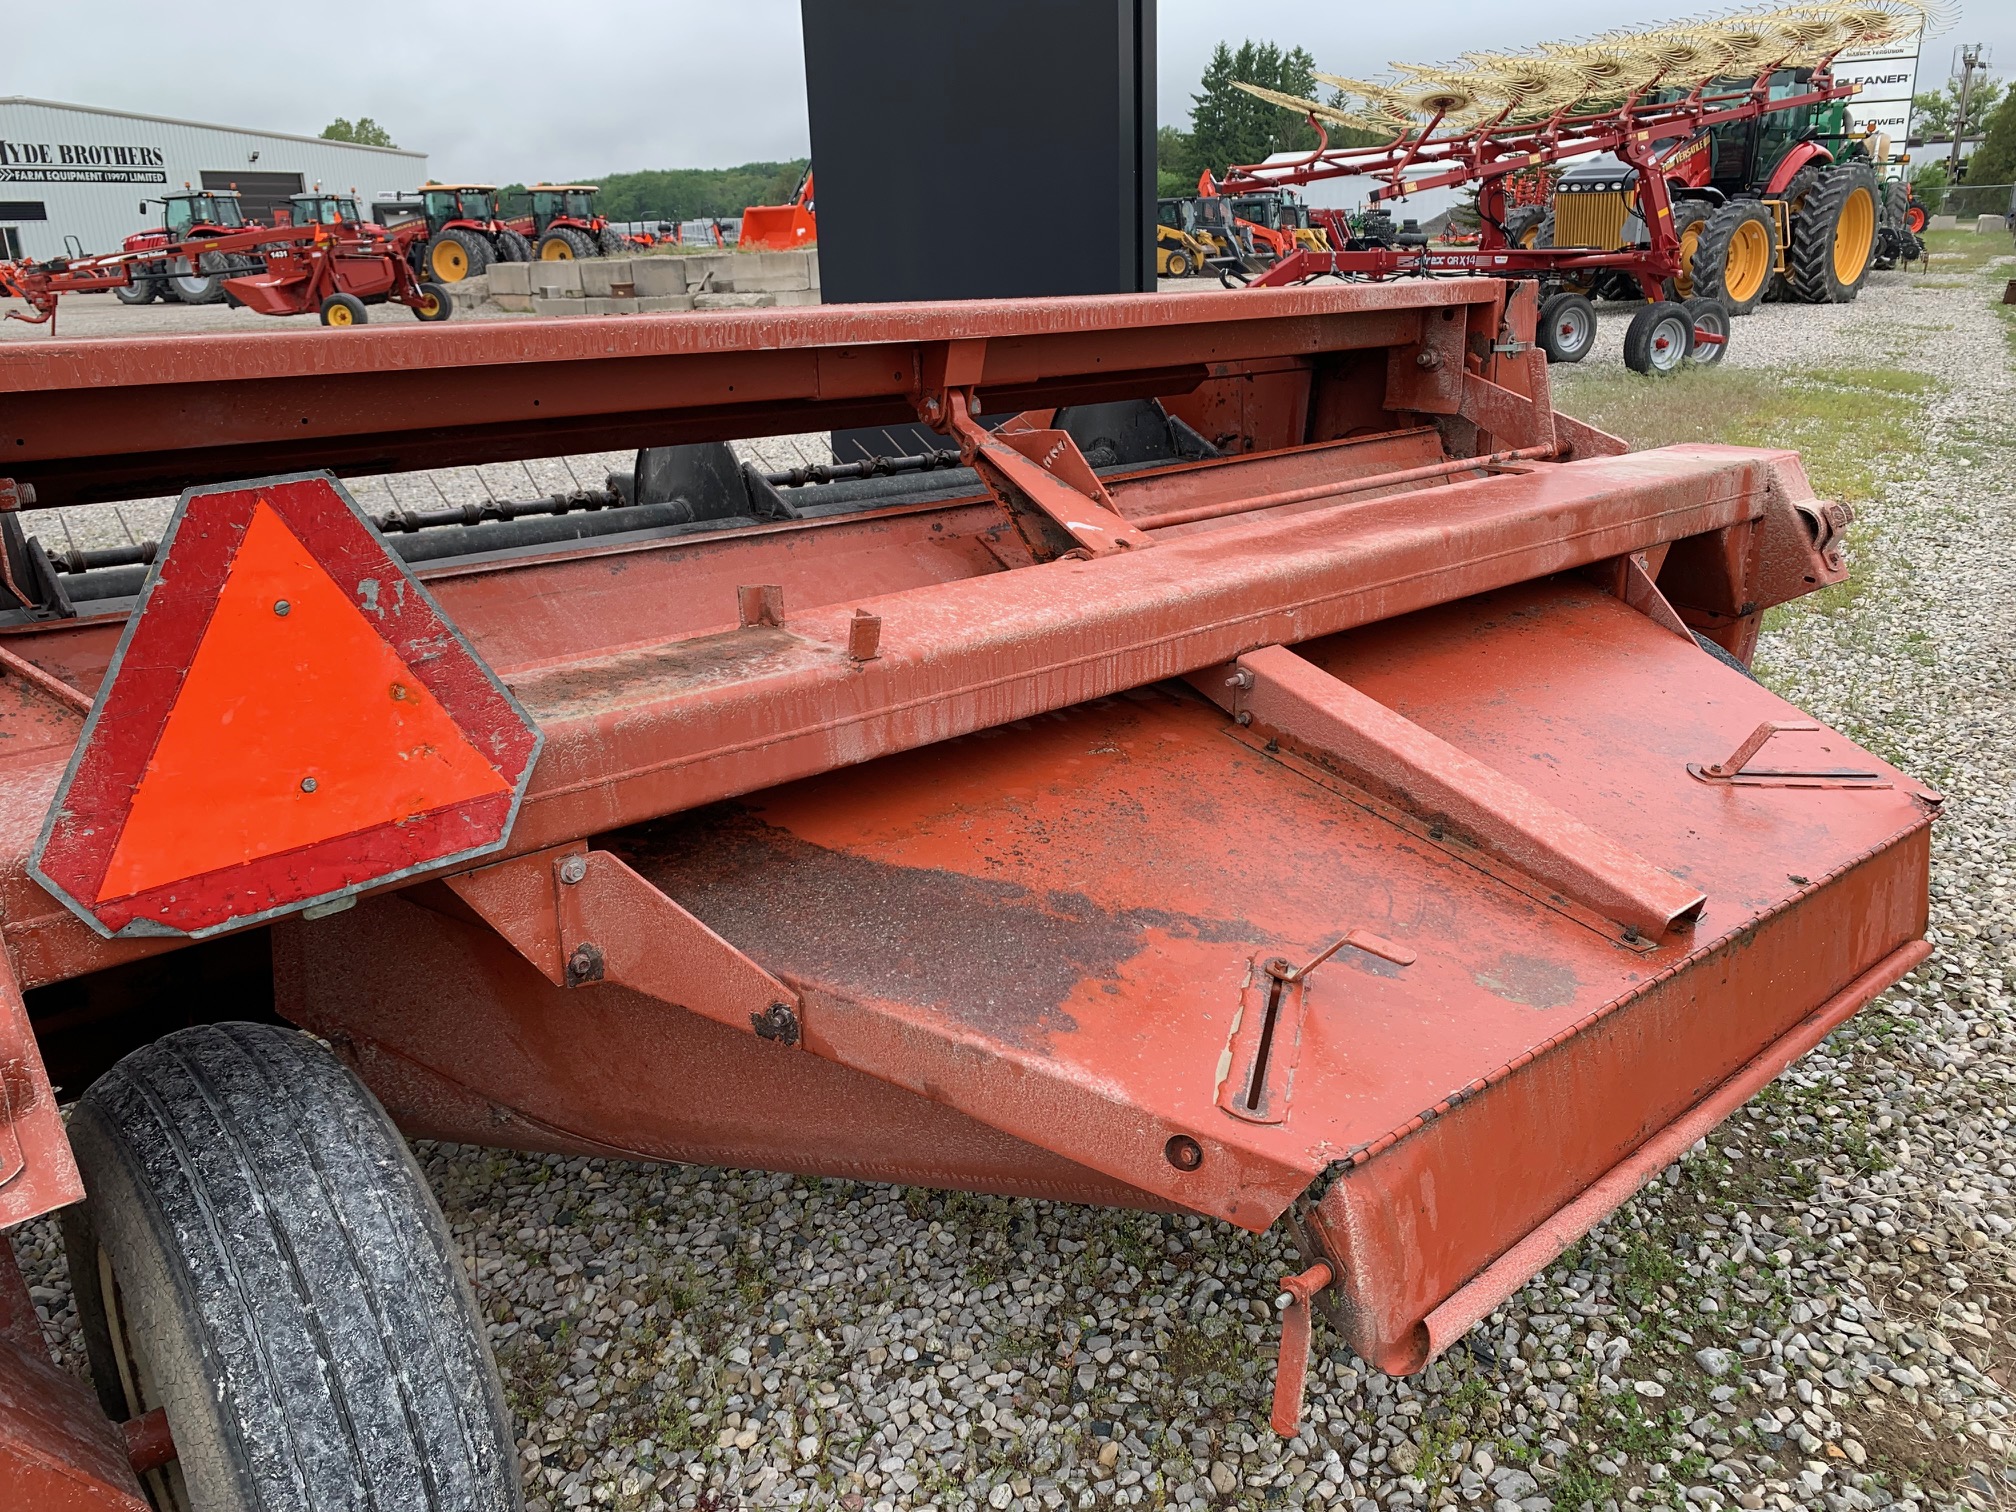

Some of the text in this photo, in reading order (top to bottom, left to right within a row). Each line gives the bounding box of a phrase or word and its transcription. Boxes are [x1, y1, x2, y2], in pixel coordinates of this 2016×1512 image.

[1842, 117, 1905, 127] FLOWER
[57, 144, 164, 166] BROTHERS
[14, 169, 164, 183] FARM EQUIPMENT (1997) LIMITED
[269, 249, 288, 259] 1431
[1413, 254, 1445, 266] strex
